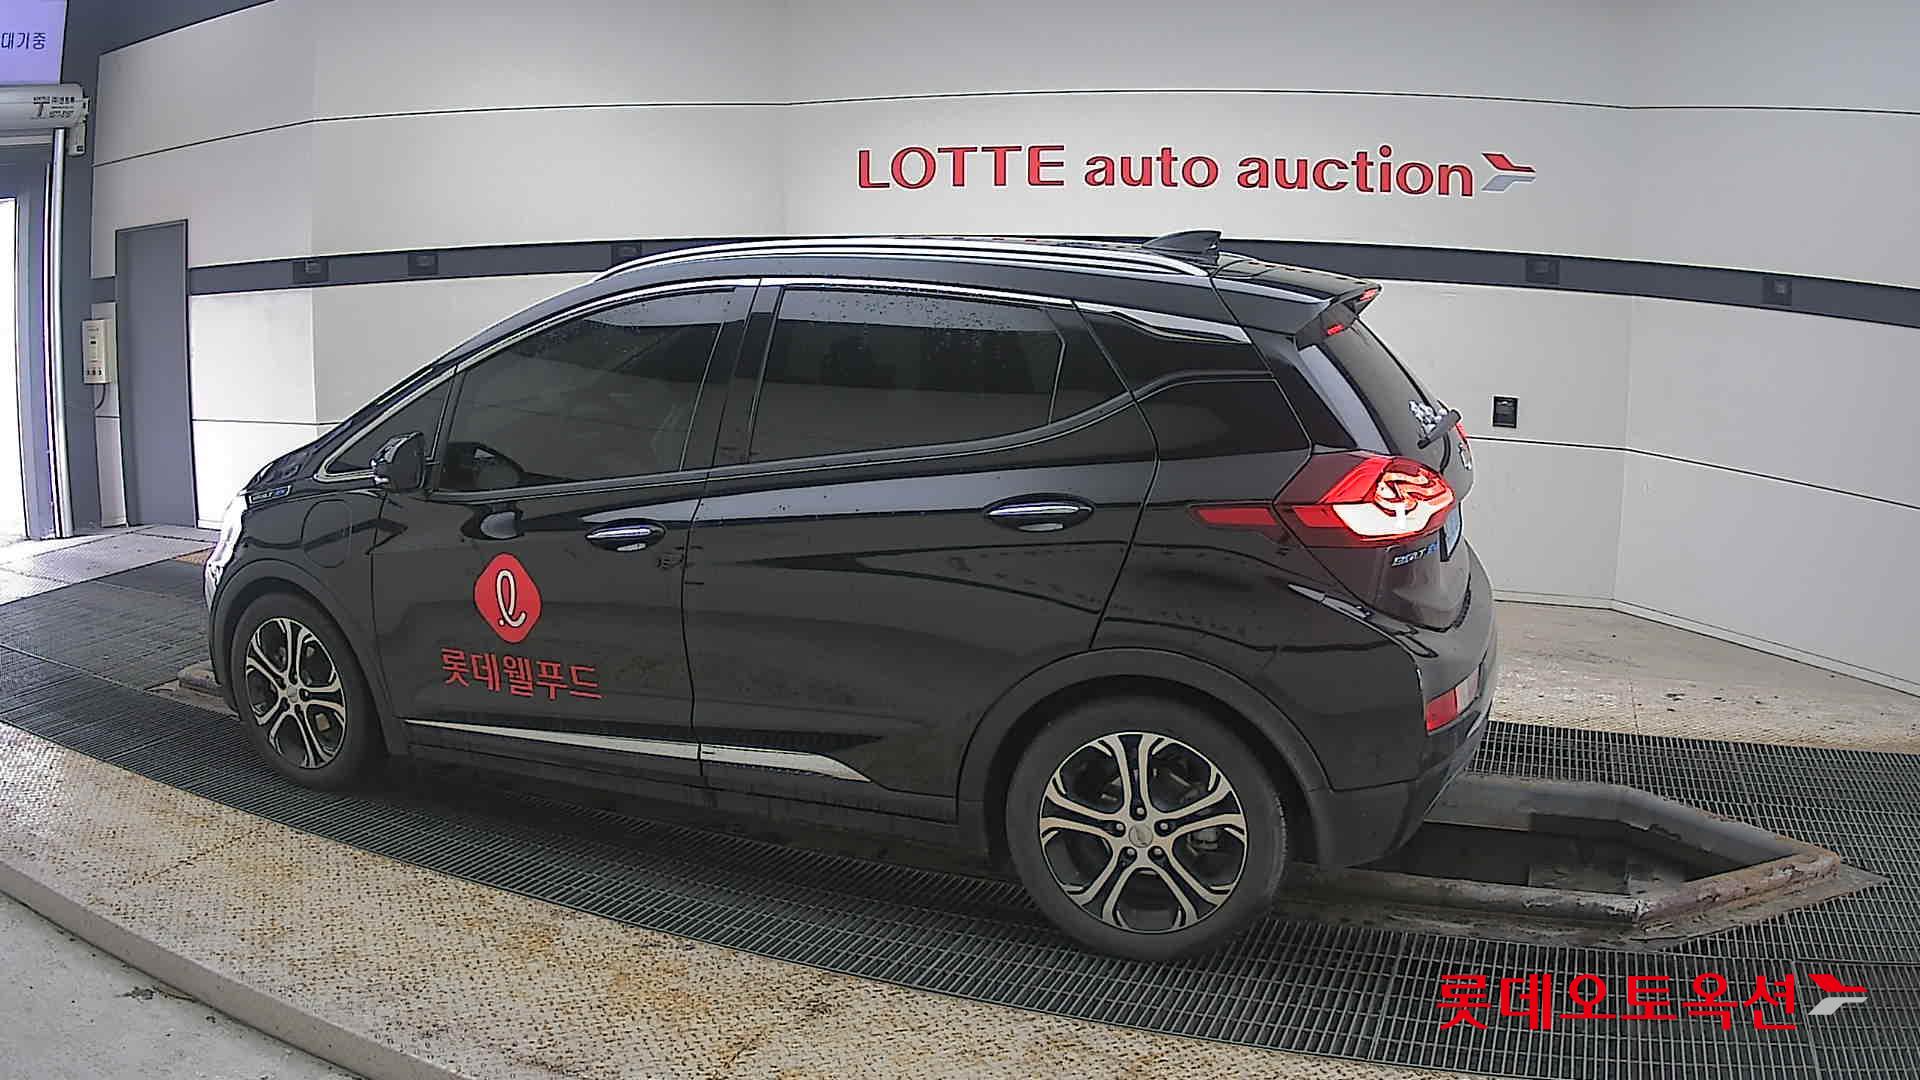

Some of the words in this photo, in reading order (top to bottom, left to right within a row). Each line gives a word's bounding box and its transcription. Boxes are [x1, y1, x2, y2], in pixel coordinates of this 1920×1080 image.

[1, 31, 47, 50] 대기중
[857, 144, 1066, 190] LOTTE
[1083, 146, 1220, 188] auto
[1236, 144, 1475, 197] auction
[440, 647, 604, 701] 롯데웰푸드
